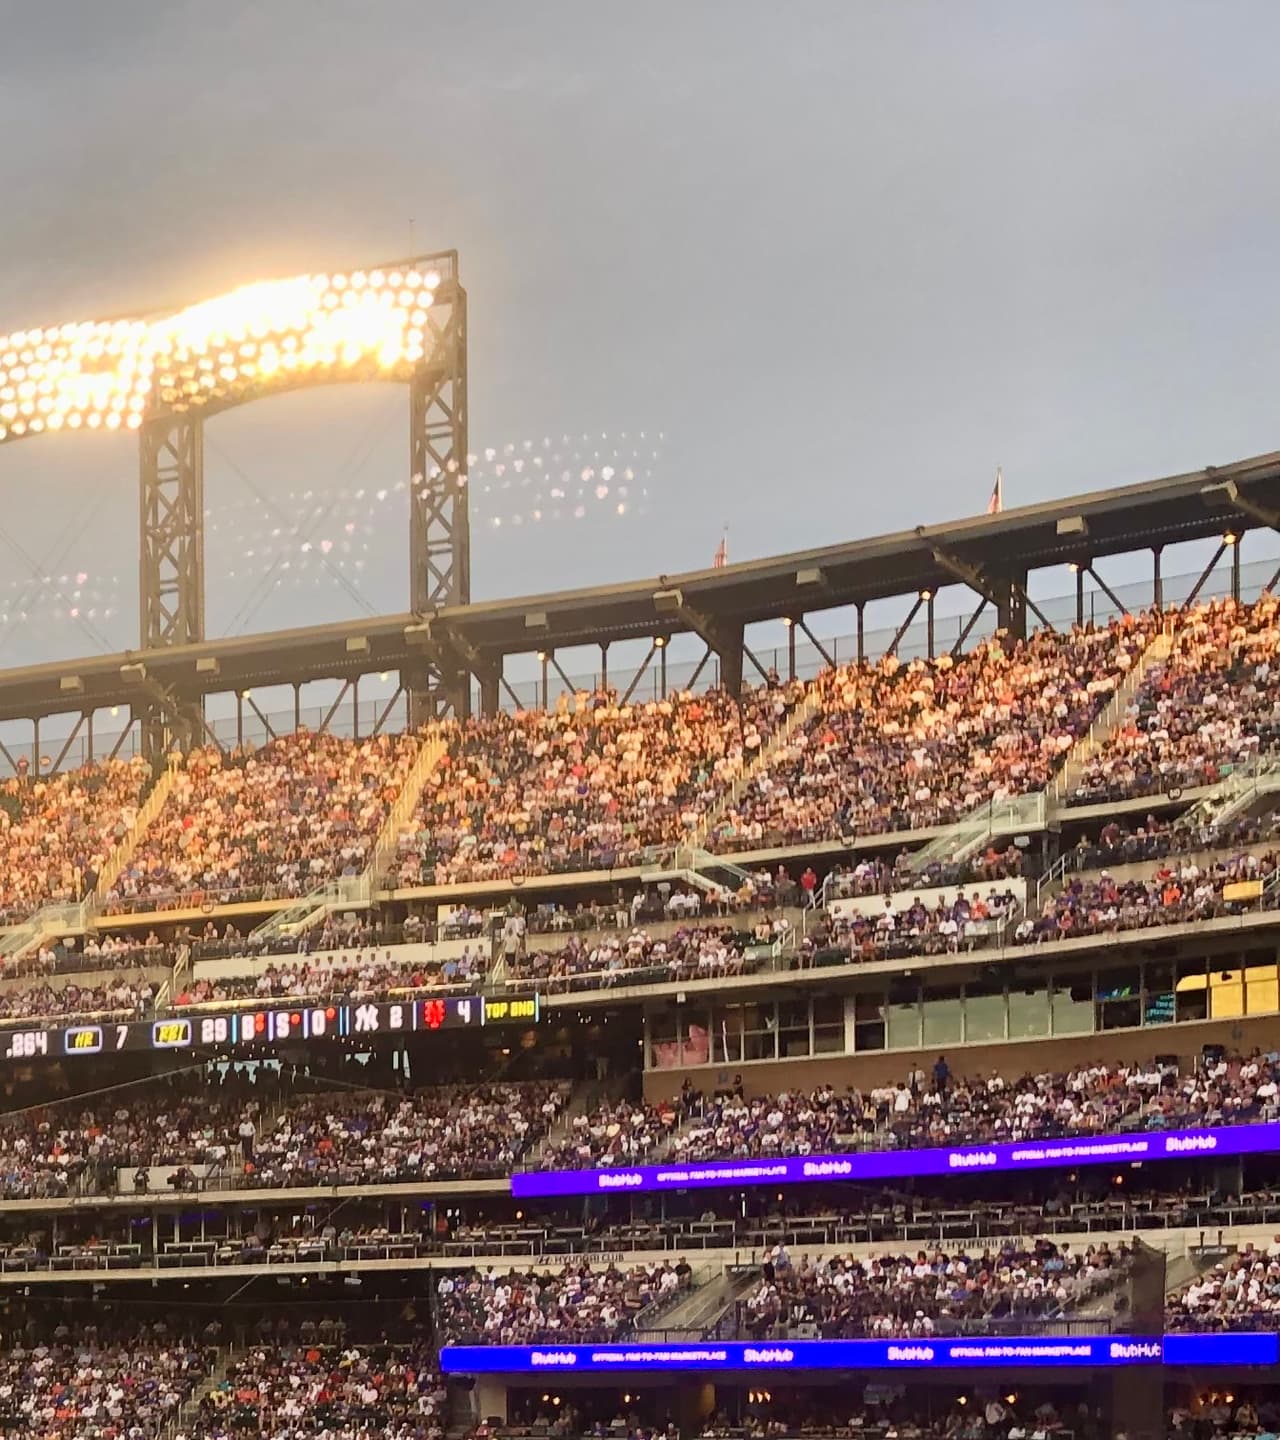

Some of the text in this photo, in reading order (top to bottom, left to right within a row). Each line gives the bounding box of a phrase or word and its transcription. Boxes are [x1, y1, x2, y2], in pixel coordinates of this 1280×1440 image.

[456, 1000, 471, 1024] 4
[486, 1003, 508, 1018] TOP
[74, 1025, 128, 1050] HR 7
[158, 1024, 187, 1042] RBI
[1166, 1136, 1217, 1151] StubHub
[949, 1151, 997, 1167] StubHub
[803, 1162, 852, 1176] StubHub
[598, 1174, 643, 1187] StubHub
[554, 1253, 624, 1265] HYUNDAI CLUB
[743, 1349, 794, 1363] StubHub
[888, 1346, 934, 1361] StubHub
[1110, 1342, 1161, 1359] StubHub
[531, 1352, 577, 1365] StubHub
